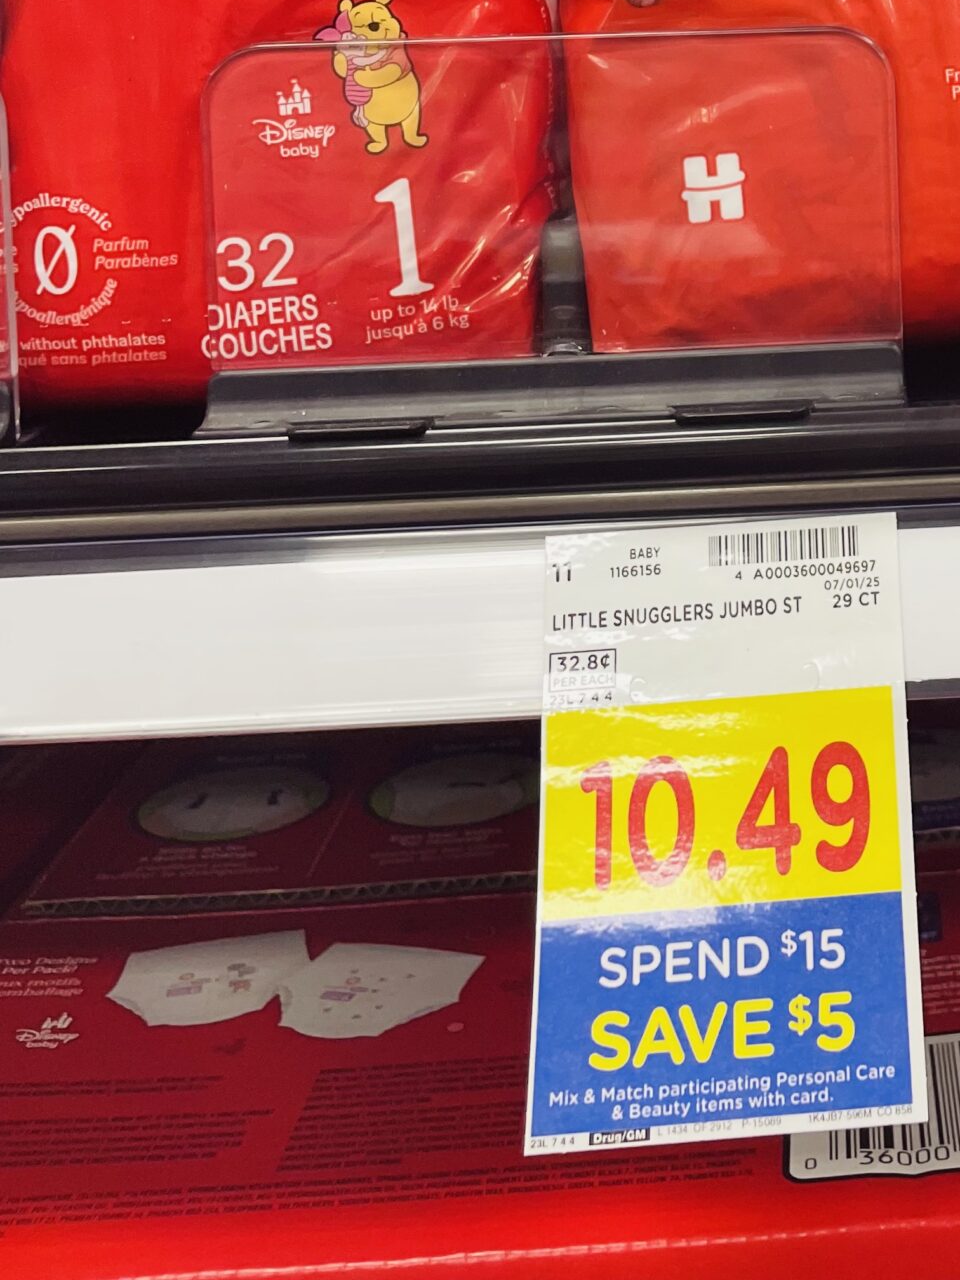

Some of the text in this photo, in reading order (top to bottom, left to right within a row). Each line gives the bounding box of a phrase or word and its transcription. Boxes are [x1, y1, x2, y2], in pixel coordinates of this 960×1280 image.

[252, 119, 335, 147] Disney
[280, 142, 320, 158] baby
[93, 236, 149, 253] Parfum
[374, 177, 435, 298] 1
[95, 253, 178, 270] Parabènes
[216, 232, 298, 292] 32
[207, 294, 319, 331] DIAPERS
[370, 307, 393, 322] up
[397, 303, 416, 318] to
[442, 295, 459, 311] lb
[20, 333, 166, 352] without phthalates
[201, 323, 332, 360] COUCHES
[366, 313, 470, 344] jusqu'à 6 kg
[51, 349, 167, 367] sans phtalates
[552, 547, 661, 583] 11 BABY
[610, 564, 662, 579] 1166156
[735, 559, 876, 581] 4 A0003600049697
[824, 576, 880, 592] 07/01/25
[553, 591, 880, 632] LITTLE SNUGGLERS JUMBO ST 29 CT
[557, 653, 611, 672] 32.8¢
[580, 740, 871, 892] 10.49
[598, 927, 847, 989] SPEND $15
[588, 991, 856, 1072] SAVE $5
[549, 1064, 896, 1108] Mix & Match participating Personal Care
[611, 1086, 834, 1121] & Beauty items with card.
[592, 1129, 647, 1146] Drug/GM
[804, 1157, 817, 1170] 0
[859, 1145, 950, 1166] 36000
